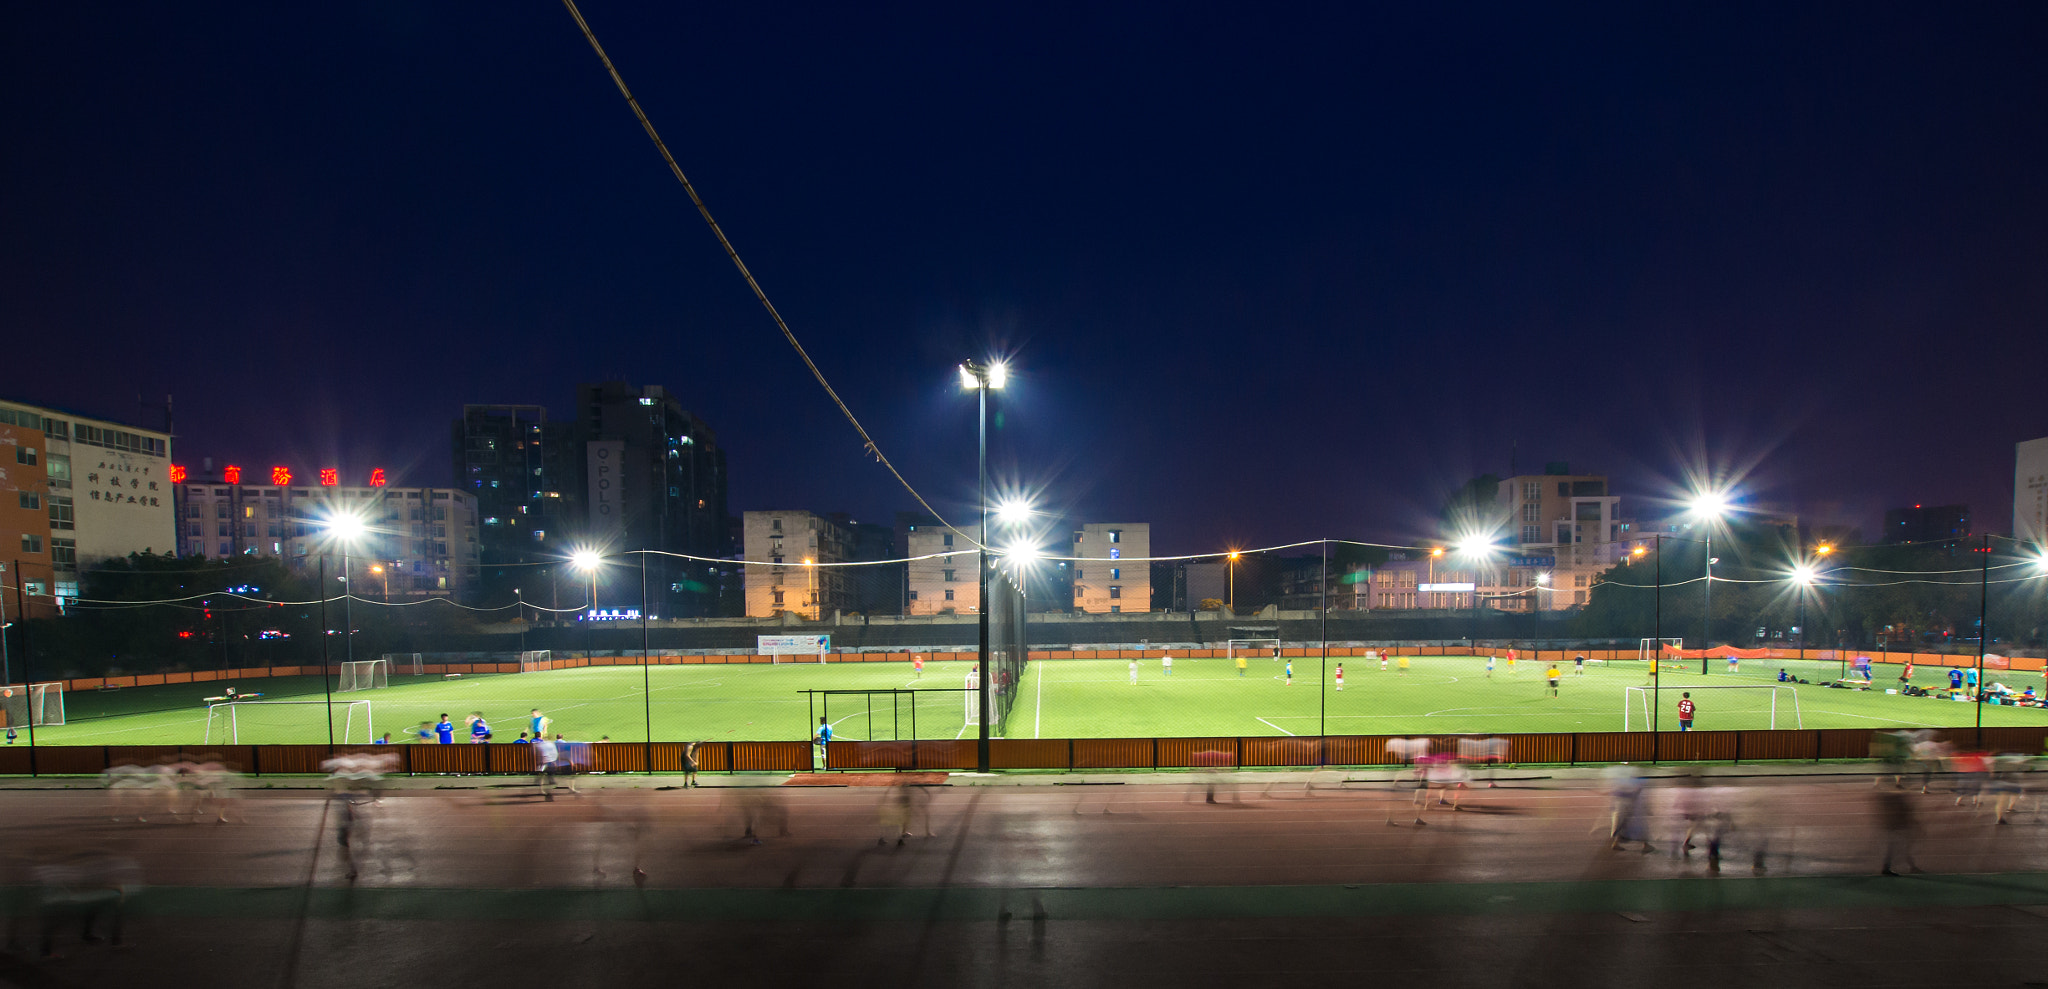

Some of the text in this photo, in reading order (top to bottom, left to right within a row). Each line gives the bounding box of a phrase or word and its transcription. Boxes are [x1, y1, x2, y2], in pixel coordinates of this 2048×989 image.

[88, 472, 159, 491] 科技学院
[89, 489, 160, 507] 信息产业学院
[1680, 704, 1691, 713] 29
